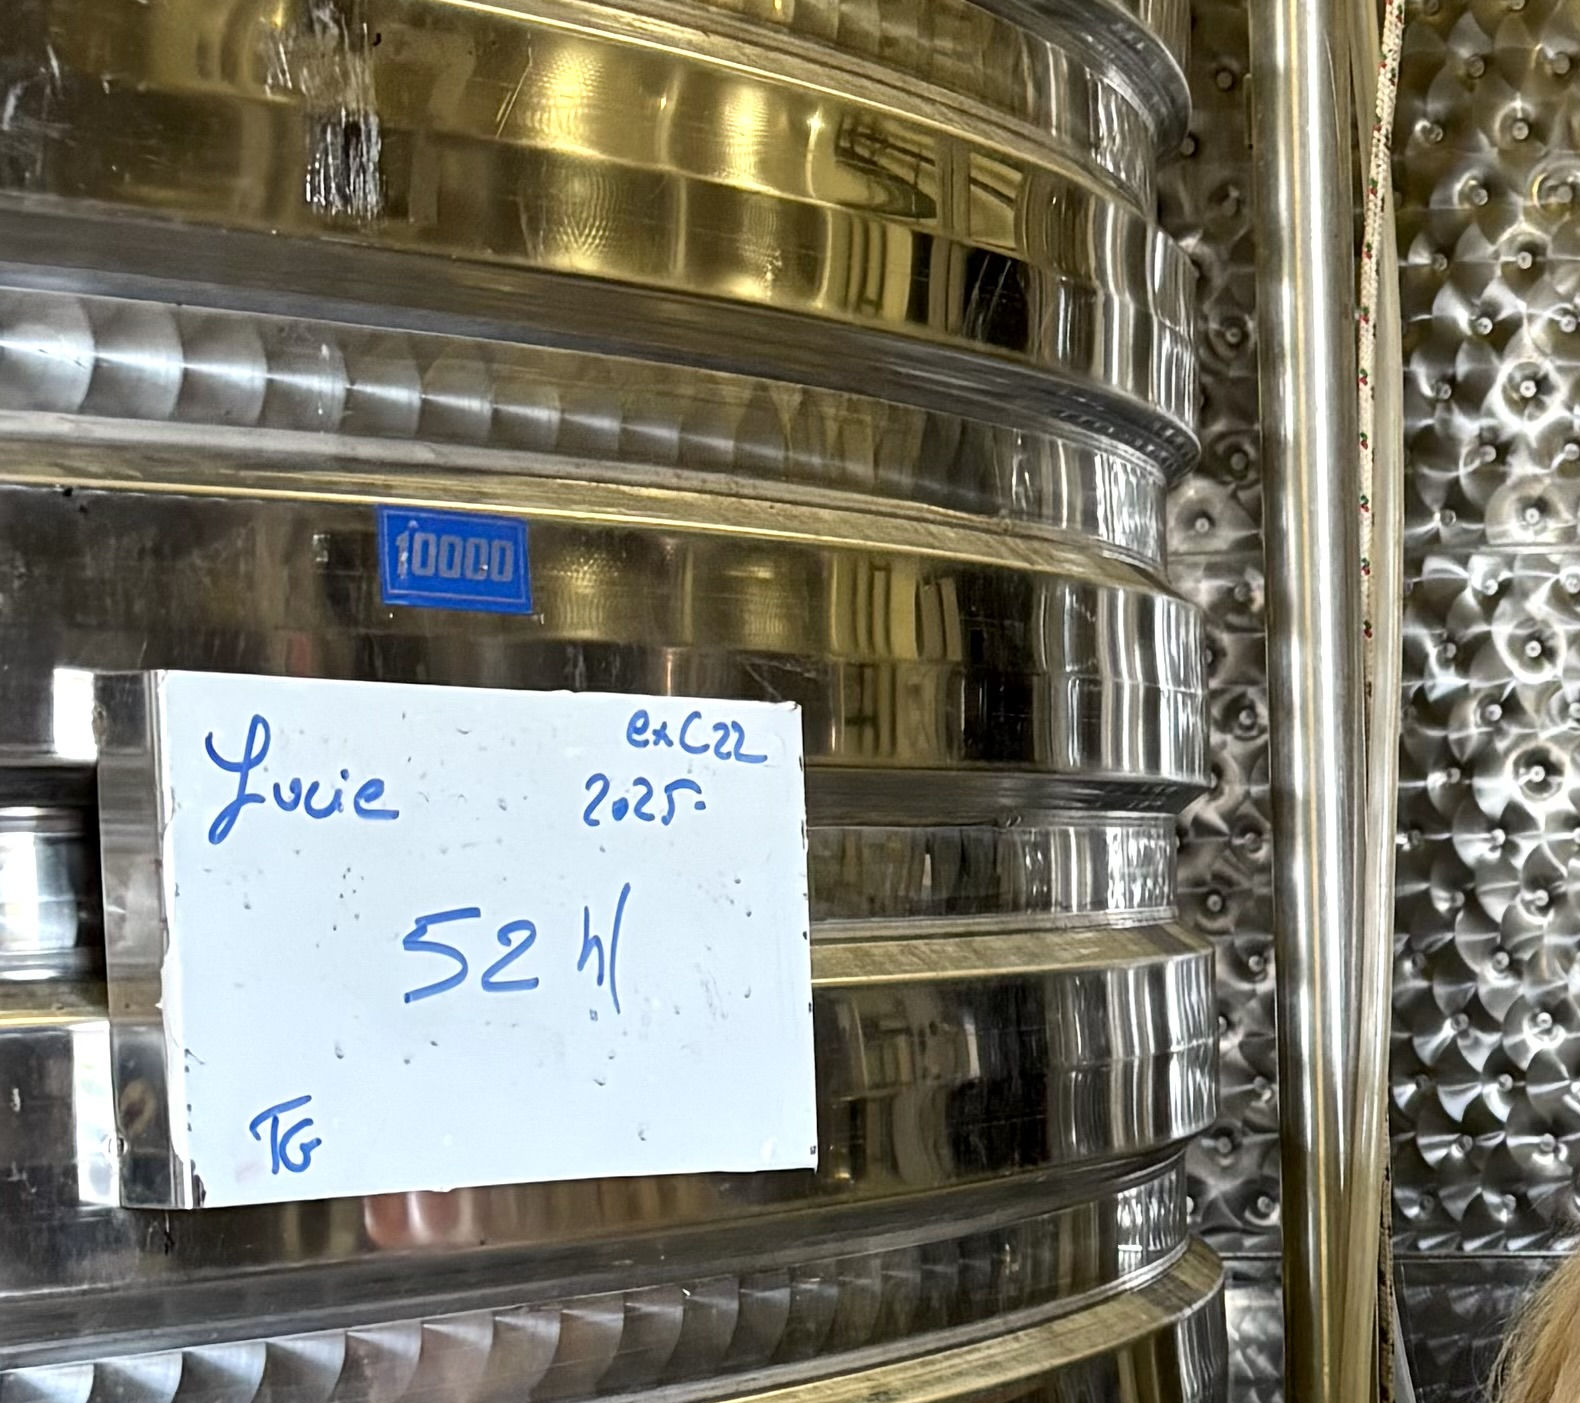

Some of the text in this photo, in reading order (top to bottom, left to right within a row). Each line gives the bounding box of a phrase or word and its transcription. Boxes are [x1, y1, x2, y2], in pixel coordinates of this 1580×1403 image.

[395, 529, 515, 583] 10000
[206, 716, 399, 845] Lucie
[403, 908, 539, 1004] 52
[250, 1095, 322, 1174] TG
